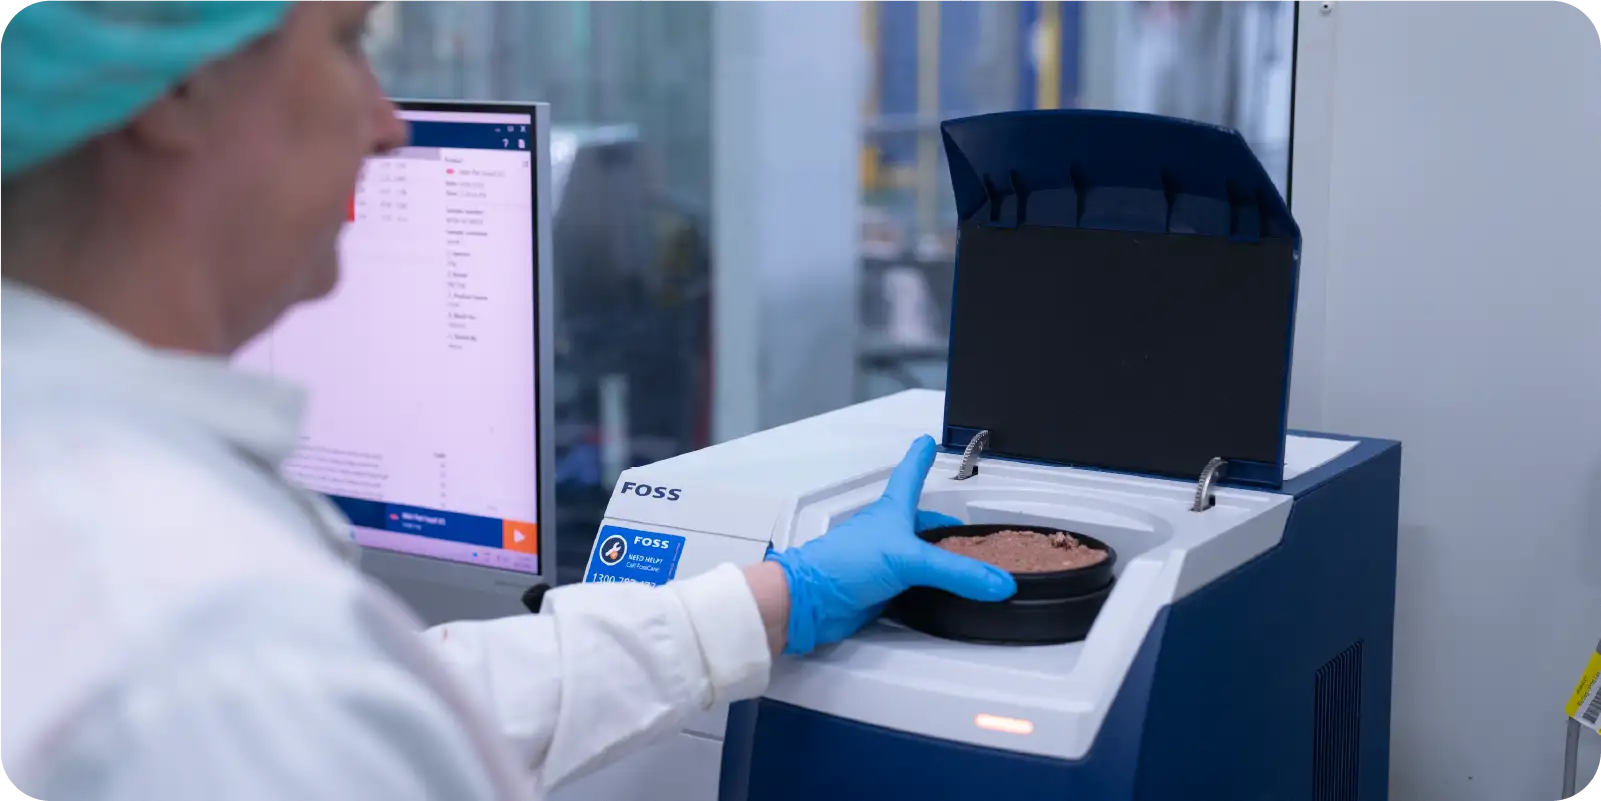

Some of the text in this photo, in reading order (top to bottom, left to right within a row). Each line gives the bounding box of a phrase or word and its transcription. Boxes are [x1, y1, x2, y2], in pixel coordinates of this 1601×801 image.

[621, 481, 682, 501] FOSS
[634, 536, 669, 549] FOSS
[628, 554, 663, 564] NEED HELP?
